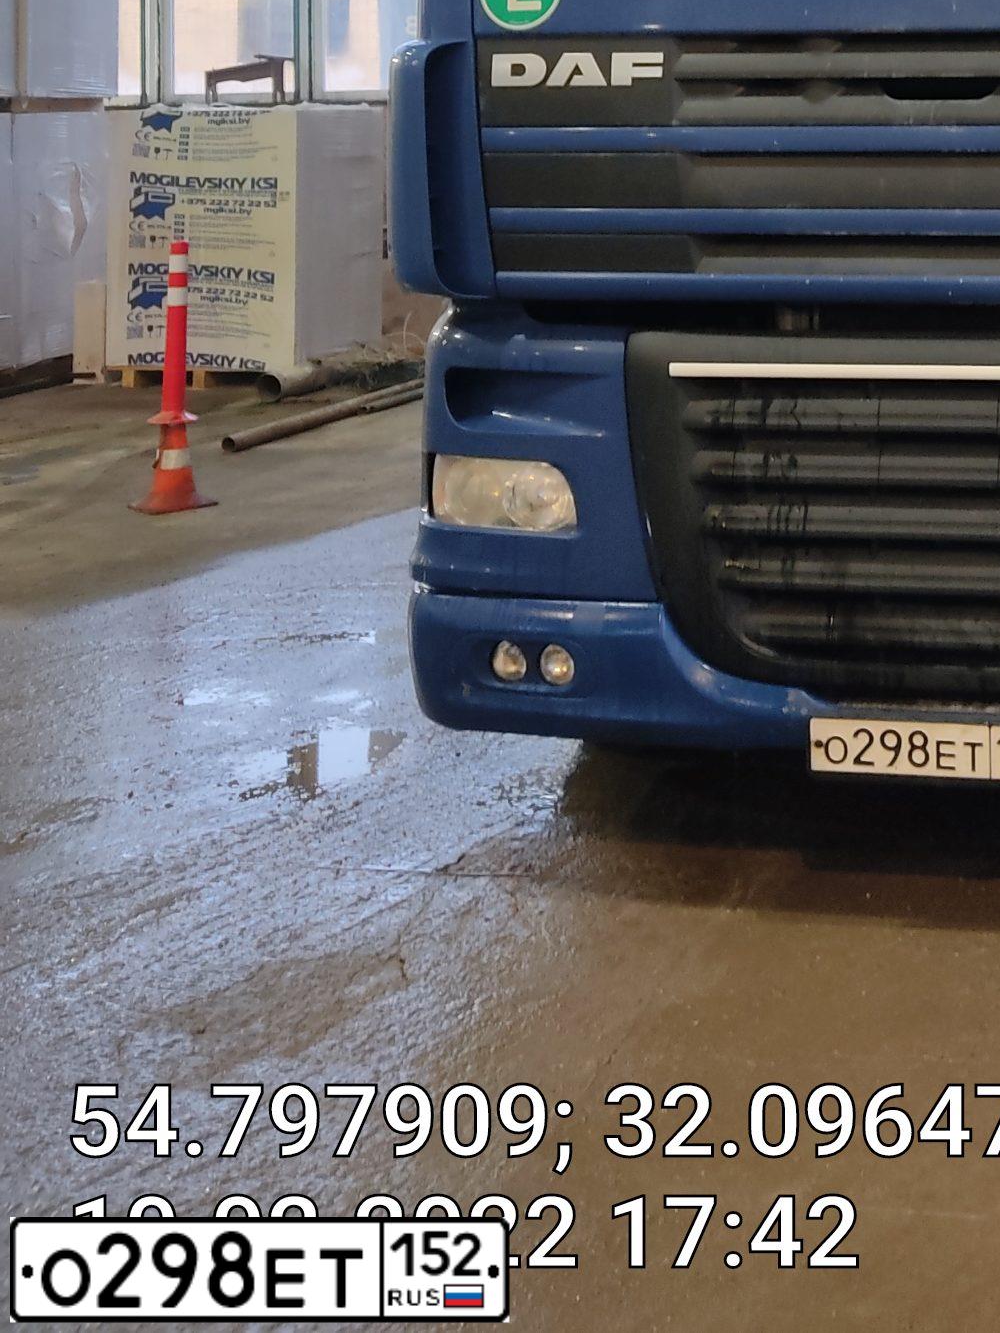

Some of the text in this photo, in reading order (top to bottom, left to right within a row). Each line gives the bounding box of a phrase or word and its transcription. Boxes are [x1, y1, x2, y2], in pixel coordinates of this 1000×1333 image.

[490, 52, 664, 87] DAF
[129, 171, 278, 190] MOGILEVSKIY KSI
[247, 268, 275, 285] KSI
[238, 357, 266, 371] KSI
[824, 728, 984, 772] O298ET
